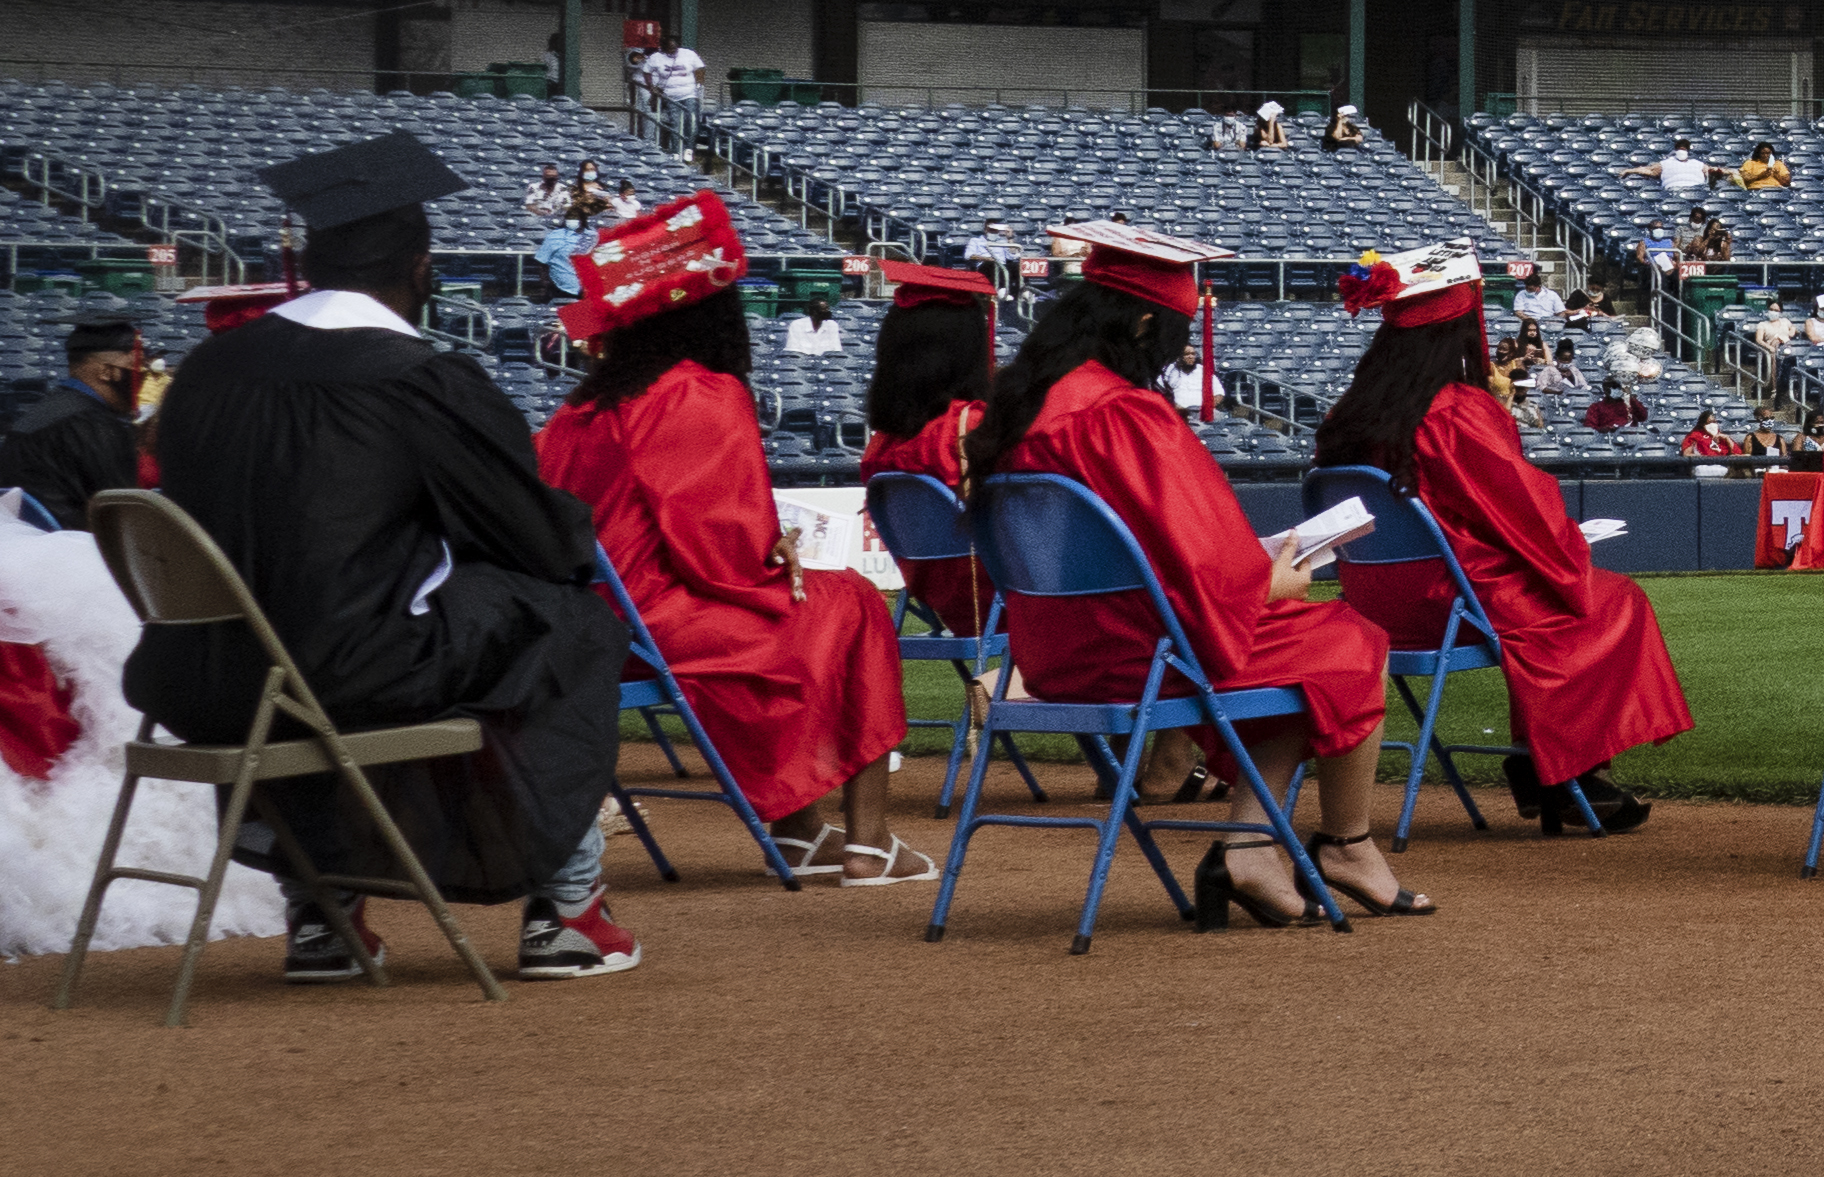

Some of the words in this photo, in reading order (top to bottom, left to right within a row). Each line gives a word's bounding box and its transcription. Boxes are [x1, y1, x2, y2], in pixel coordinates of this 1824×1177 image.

[1623, 1, 1773, 32] SERVICES
[844, 259, 869, 272] 206
[1022, 261, 1048, 274] 207
[1509, 264, 1533, 277] 207
[1681, 265, 1705, 277] 208
[1771, 500, 1813, 550] T
